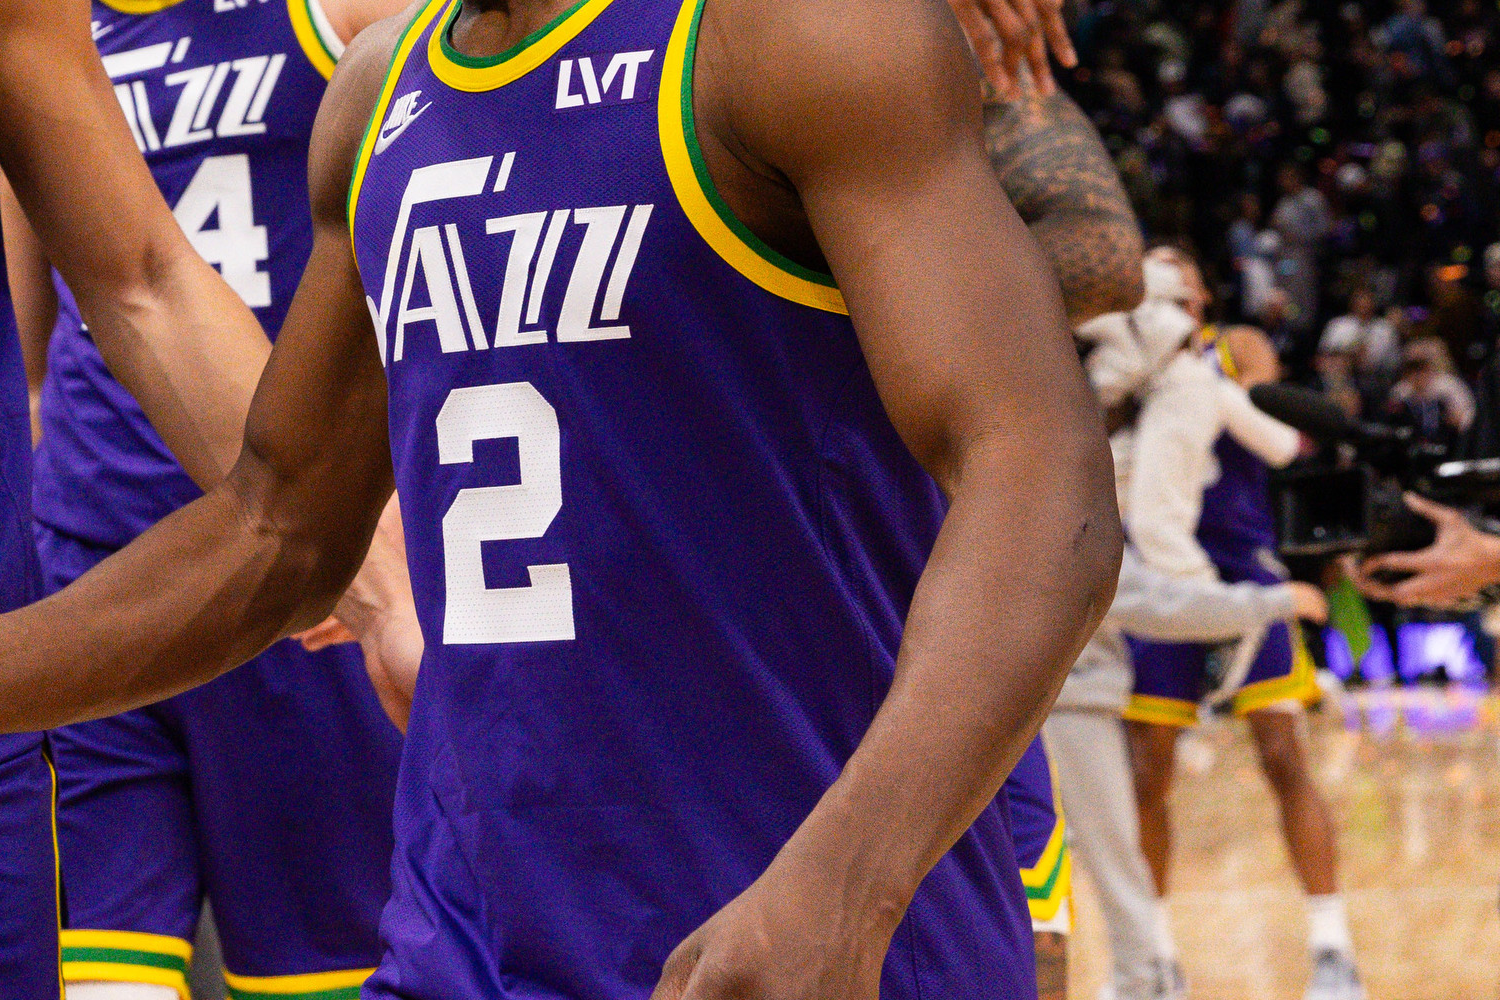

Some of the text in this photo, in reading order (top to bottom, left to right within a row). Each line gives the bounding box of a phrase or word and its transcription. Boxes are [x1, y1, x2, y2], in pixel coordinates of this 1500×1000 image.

[556, 50, 655, 110] LVT
[366, 152, 655, 368] JAZZ
[436, 382, 576, 645] 2
